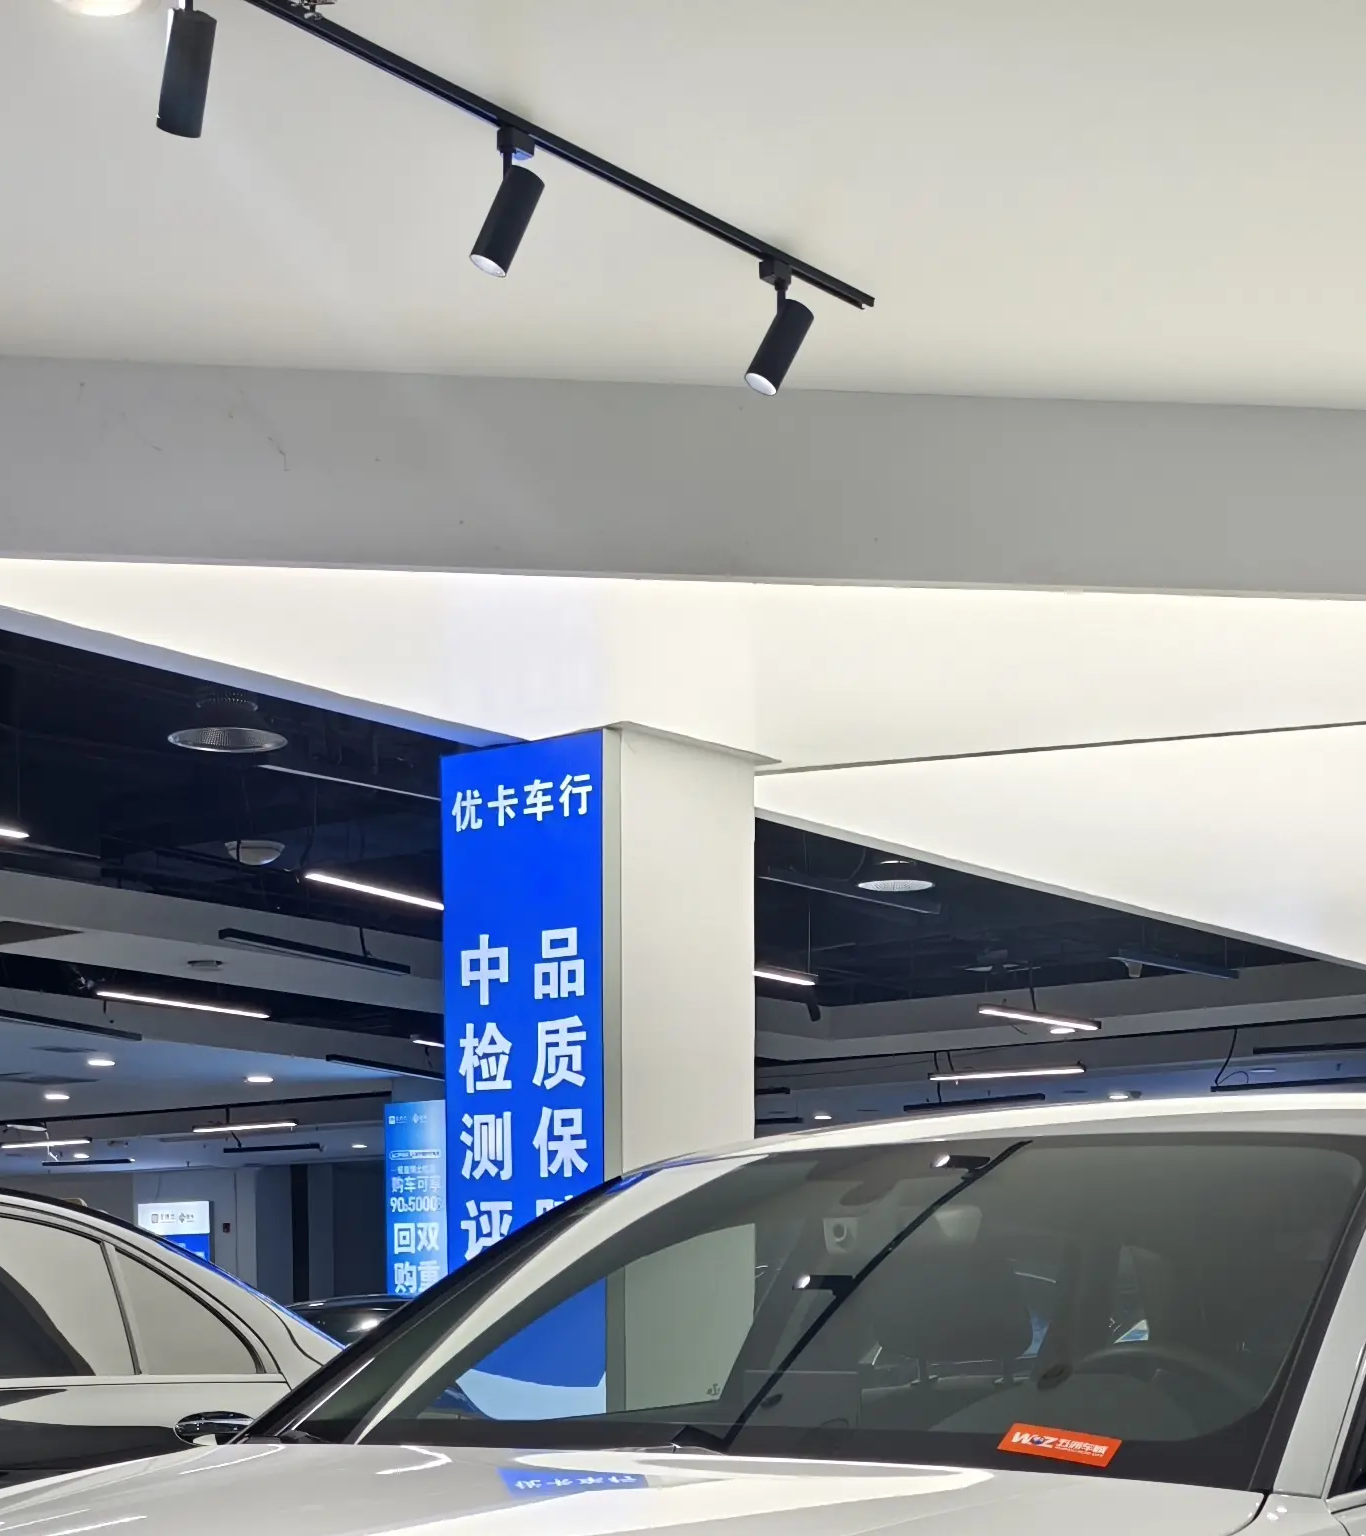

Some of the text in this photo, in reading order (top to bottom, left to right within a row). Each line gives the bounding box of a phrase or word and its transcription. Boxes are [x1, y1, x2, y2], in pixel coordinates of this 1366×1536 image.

[451, 774, 593, 832] 优卡车行
[532, 927, 588, 1217] 品质保
